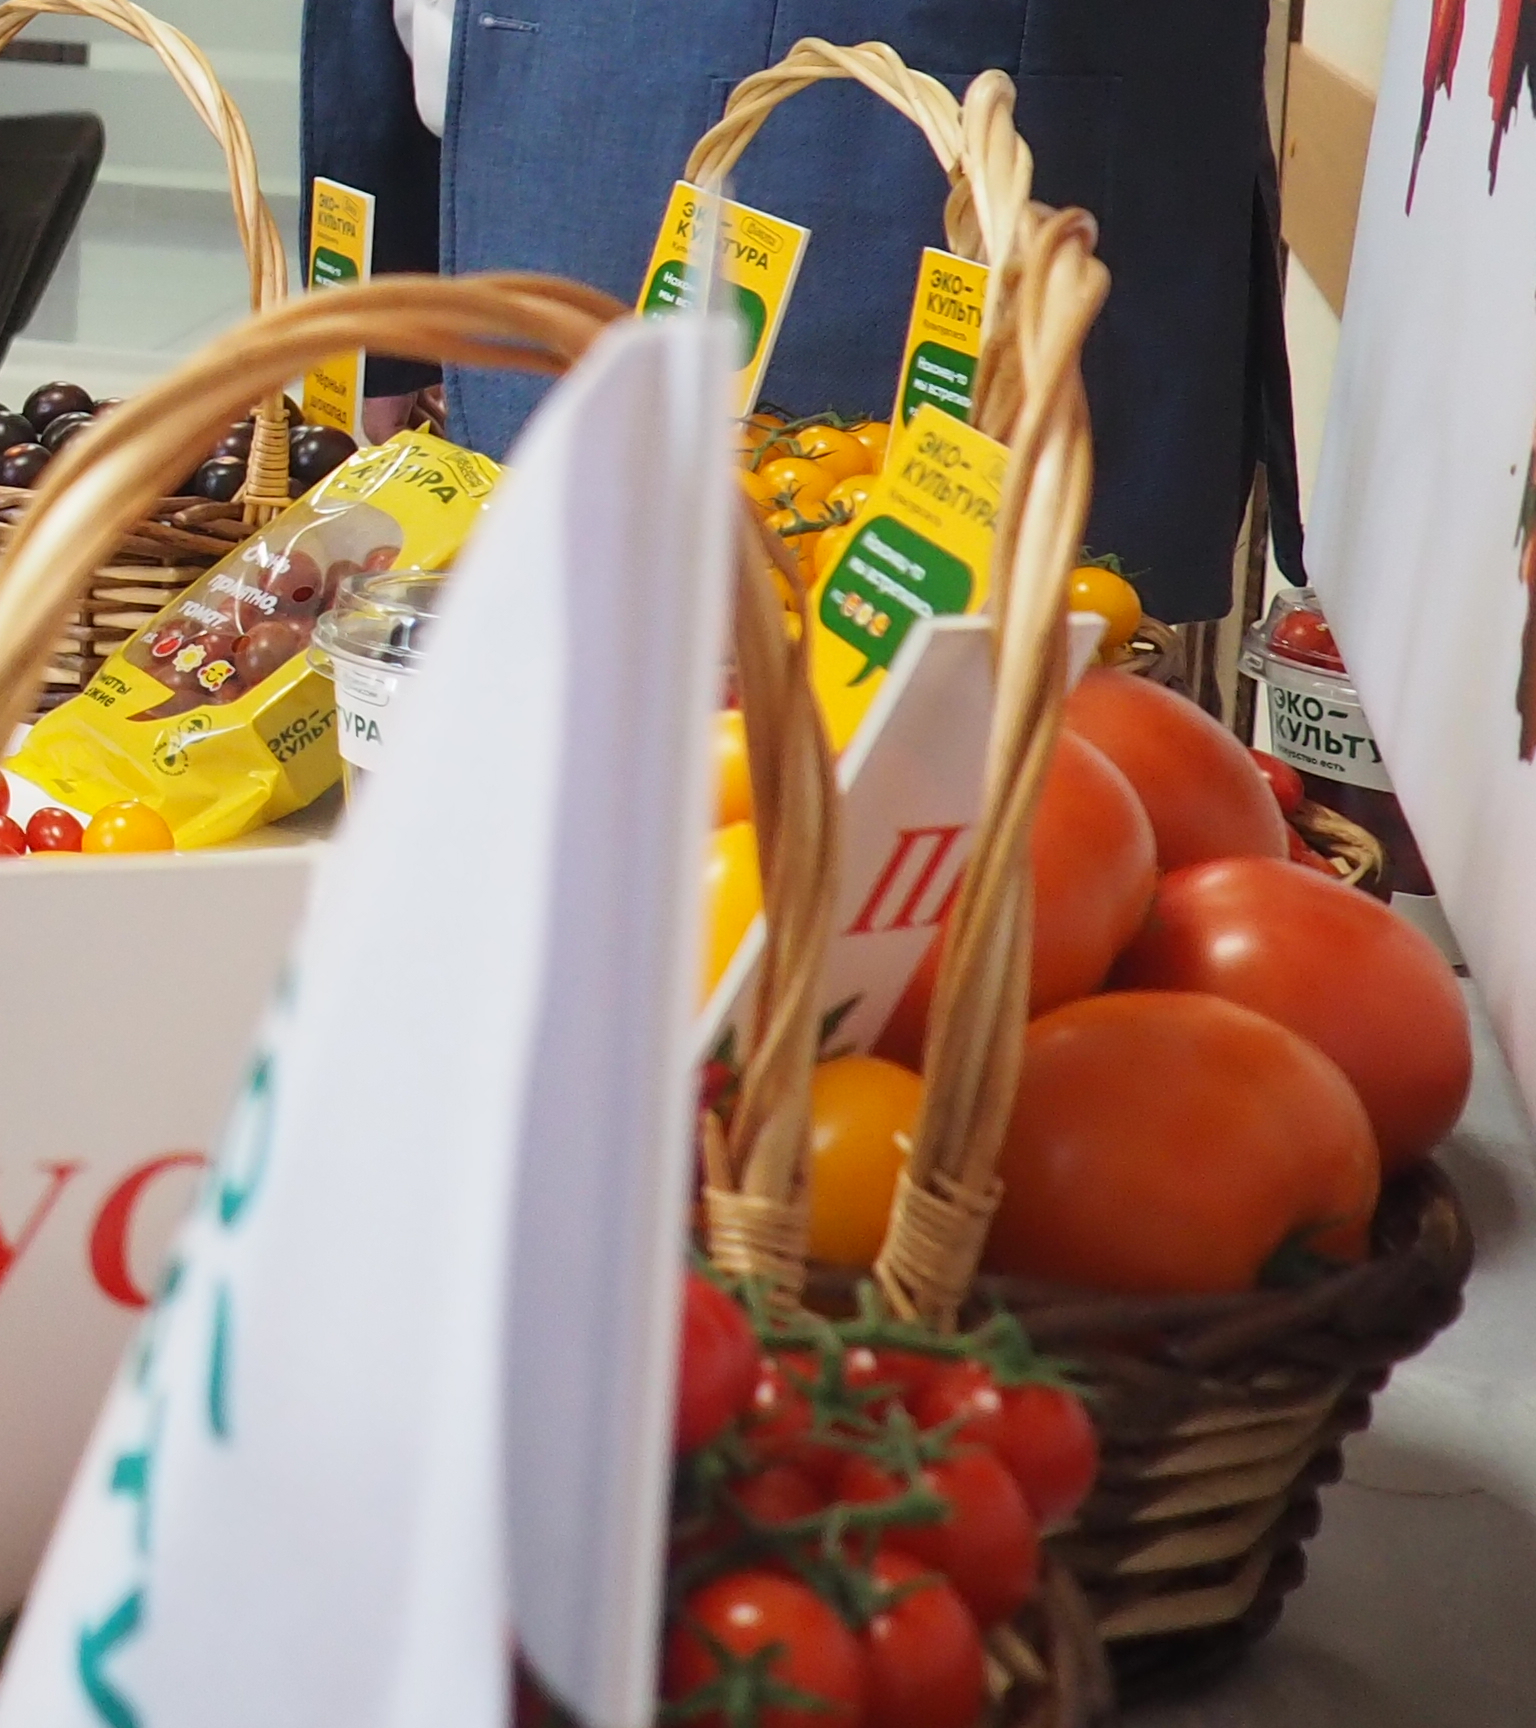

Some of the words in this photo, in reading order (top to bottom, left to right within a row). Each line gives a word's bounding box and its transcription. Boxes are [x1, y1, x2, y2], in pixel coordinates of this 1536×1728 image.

[682, 201, 733, 228] ЭК-
[676, 219, 769, 270] КУТУРА
[930, 269, 974, 296] ЭКО-
[917, 430, 972, 469] ЭКО-
[1273, 687, 1349, 722] ЭКО-
[267, 709, 320, 753] ЭКО-
